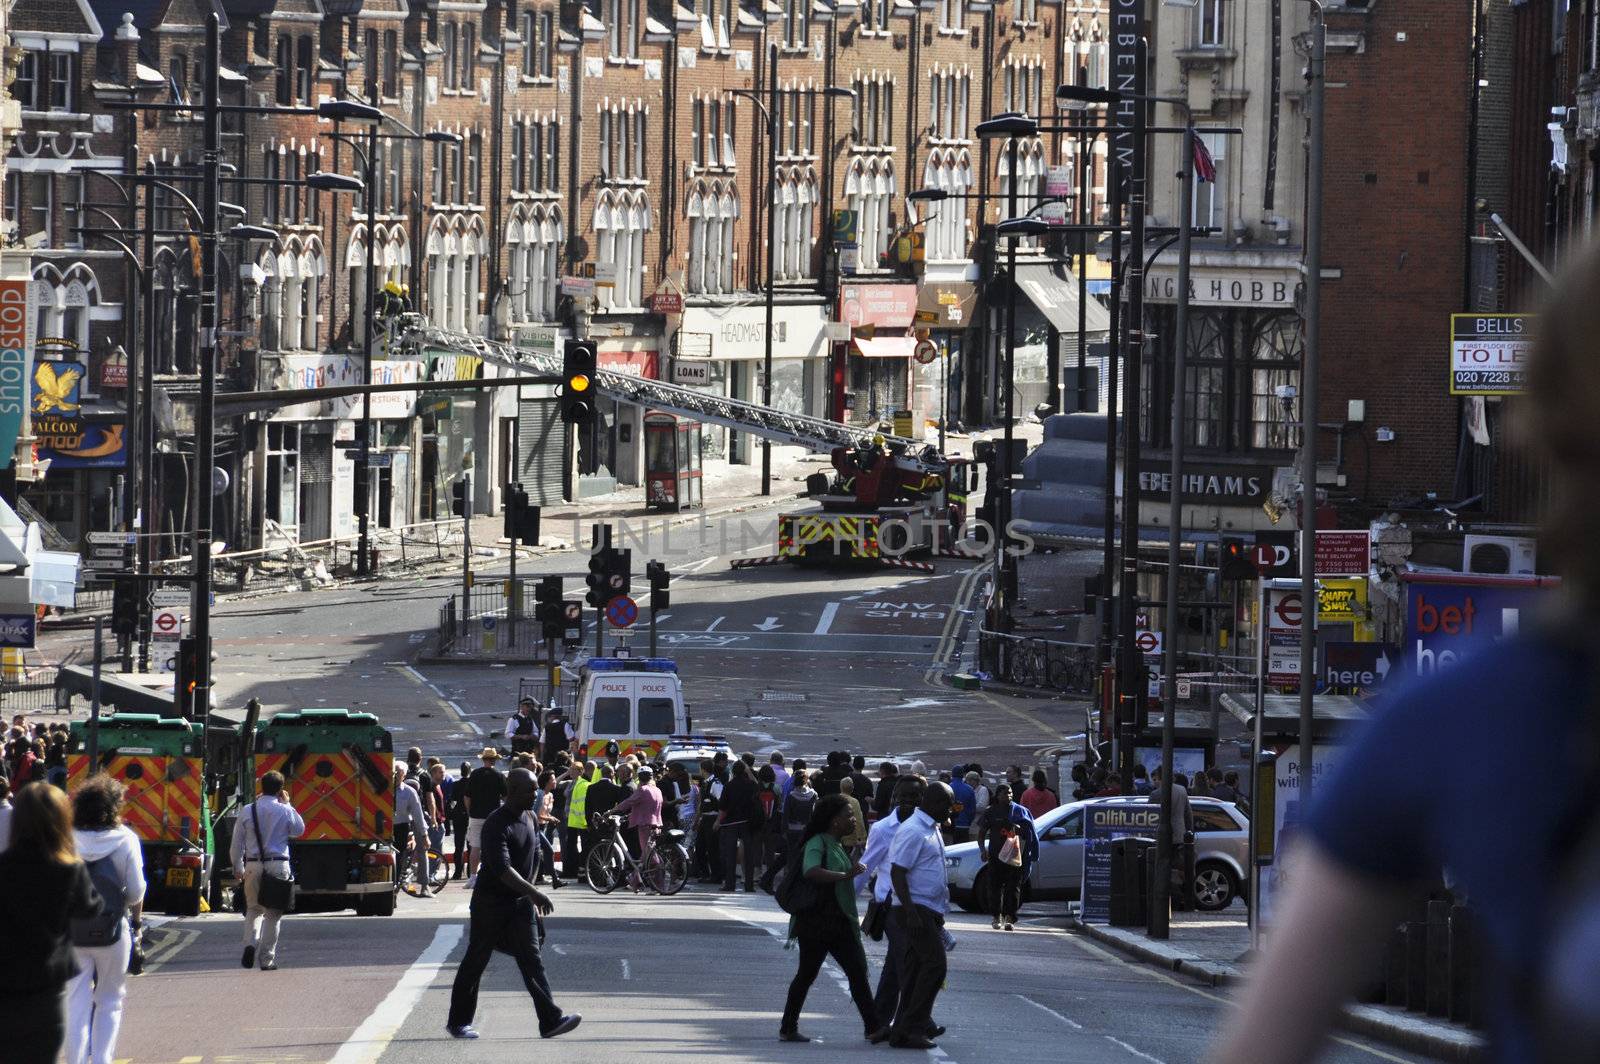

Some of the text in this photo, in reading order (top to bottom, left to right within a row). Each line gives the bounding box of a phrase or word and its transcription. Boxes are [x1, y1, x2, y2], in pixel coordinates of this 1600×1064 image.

[1210, 280, 1286, 301] HOBB
[721, 323, 780, 343] HEADMASTS
[1477, 318, 1523, 333] BELLS
[521, 332, 555, 341] VISION
[1458, 350, 1526, 363] TO LE
[353, 365, 402, 386] PRTY
[436, 354, 482, 382] SUBWAY
[677, 366, 705, 379] LOANS
[1456, 372, 1478, 383] 020
[1481, 372, 1510, 383] 7228
[1139, 472, 1260, 497] EBEHAMS
[1259, 547, 1269, 565] L
[1318, 589, 1354, 602] SNAPPY
[1416, 594, 1476, 637] bet
[0, 626, 29, 635] LIFAX
[1327, 666, 1374, 685] here
[602, 684, 626, 692] POLICE
[642, 685, 666, 693] POLICE
[1288, 762, 1322, 776] Pesil
[1094, 809, 1160, 827] altitude
